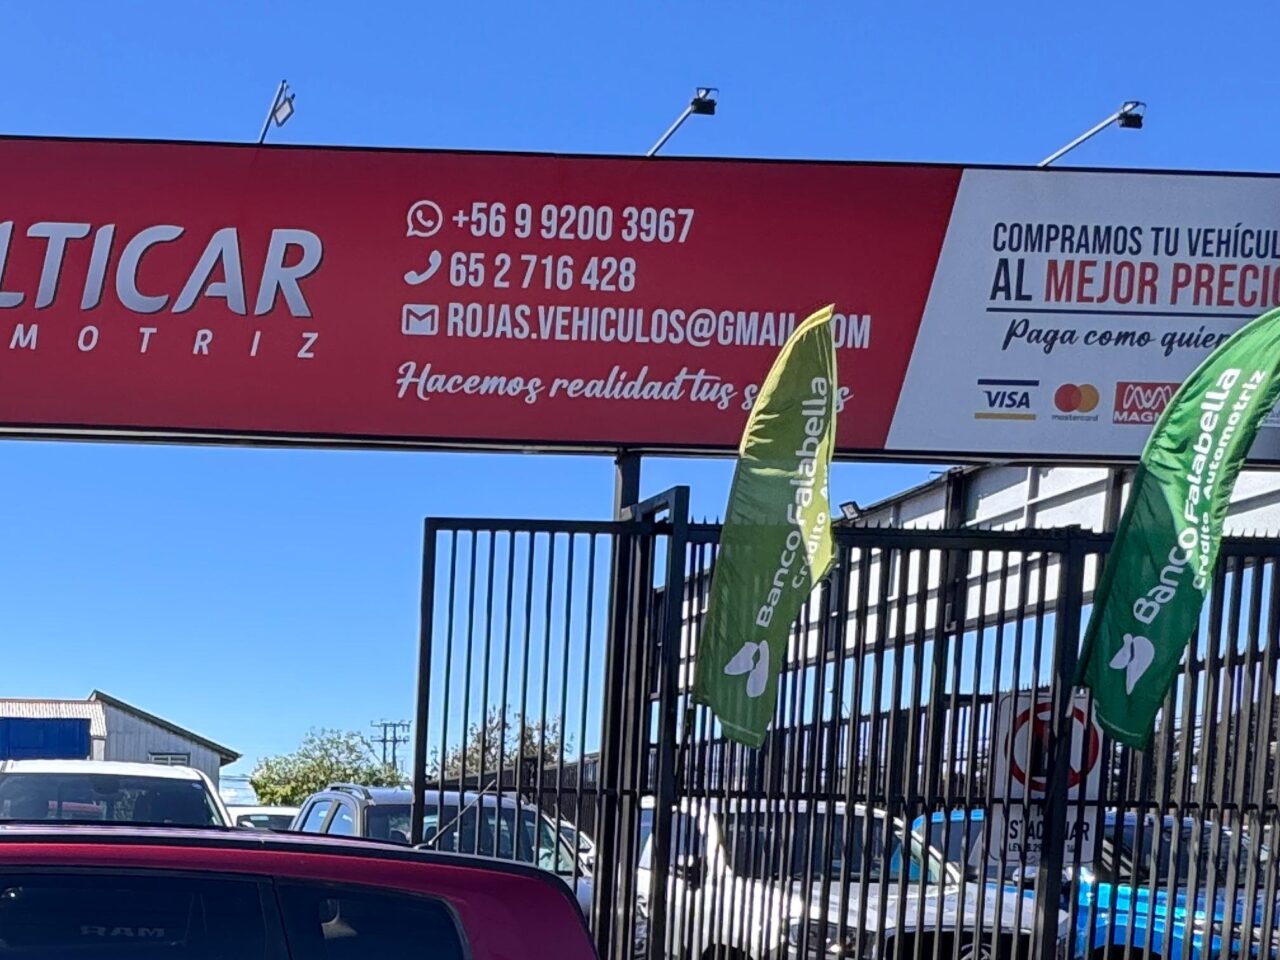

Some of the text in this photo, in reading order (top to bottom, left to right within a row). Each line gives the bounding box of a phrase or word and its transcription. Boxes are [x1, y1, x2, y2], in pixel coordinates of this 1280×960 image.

[452, 202, 695, 243] +56 9 9200 3967
[992, 222, 1142, 256] COMPRAMOS
[1150, 226, 1179, 257] TU
[449, 252, 636, 293] 65 2 716 428
[990, 257, 1032, 302] AL
[1044, 259, 1159, 306] MEJOR
[447, 303, 871, 349] ROJAS.VEHICULOS@GMAIOM
[1001, 318, 1078, 355] Paga
[1084, 330, 1155, 348] como
[396, 361, 544, 404] Hacemos
[549, 364, 686, 403] realidad
[685, 367, 738, 410] tus
[983, 390, 1031, 409] VISA
[1203, 369, 1266, 501] Automotriz
[755, 376, 827, 628] Banco Falabella
[1133, 367, 1241, 625] Banco Falabella
